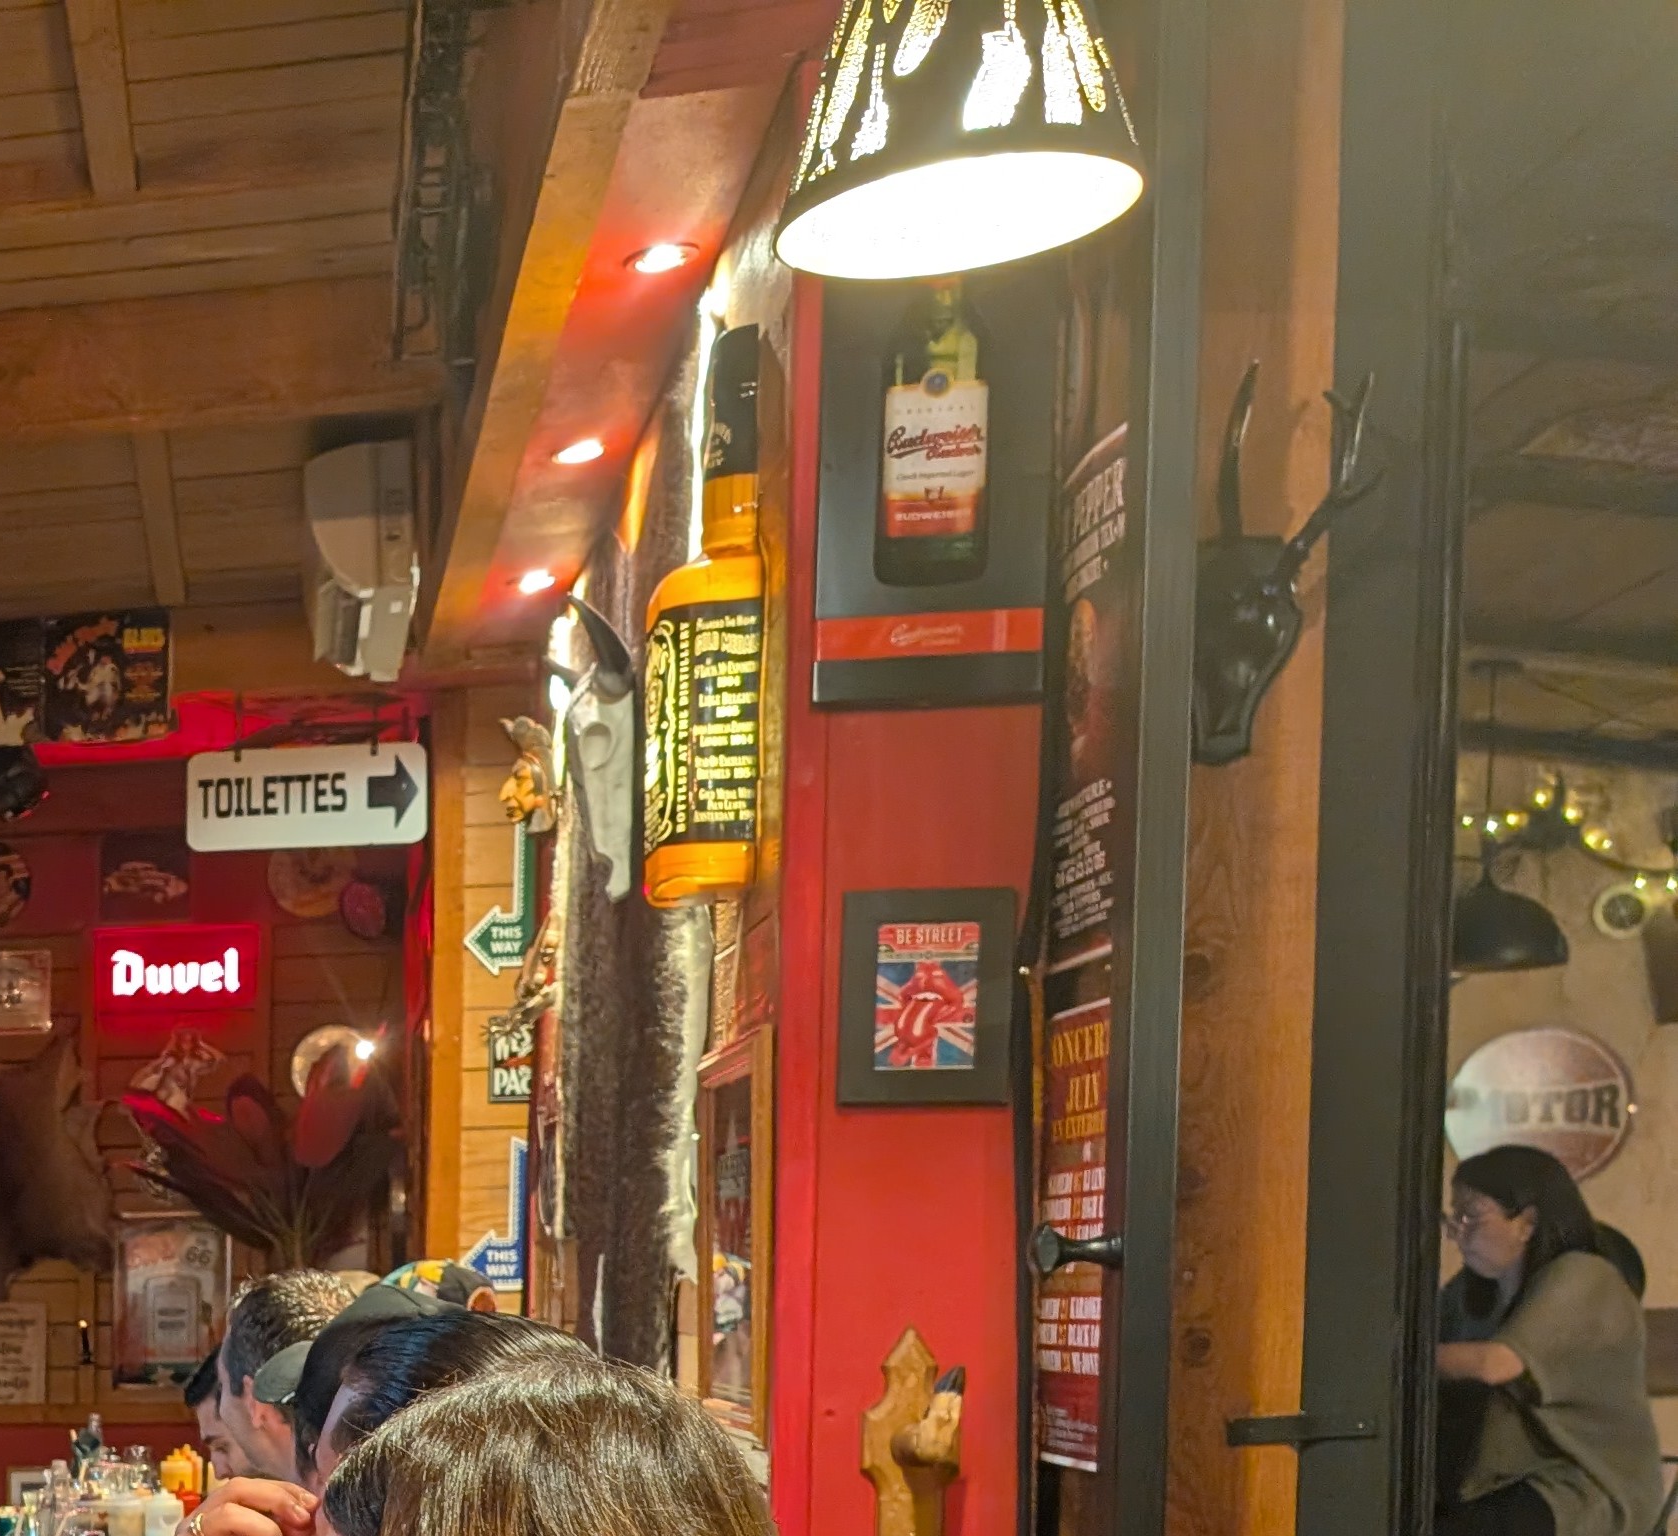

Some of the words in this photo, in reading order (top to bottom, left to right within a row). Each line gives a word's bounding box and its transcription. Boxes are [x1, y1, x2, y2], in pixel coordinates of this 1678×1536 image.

[198, 772, 347, 819] TOILETTES
[490, 924, 522, 940] THIS
[896, 929, 912, 945] BE
[916, 927, 962, 943] STREET
[490, 940, 522, 955] WAY
[110, 947, 240, 996] Duvel
[486, 1248, 518, 1263] THIS
[485, 1263, 517, 1277] WAY
